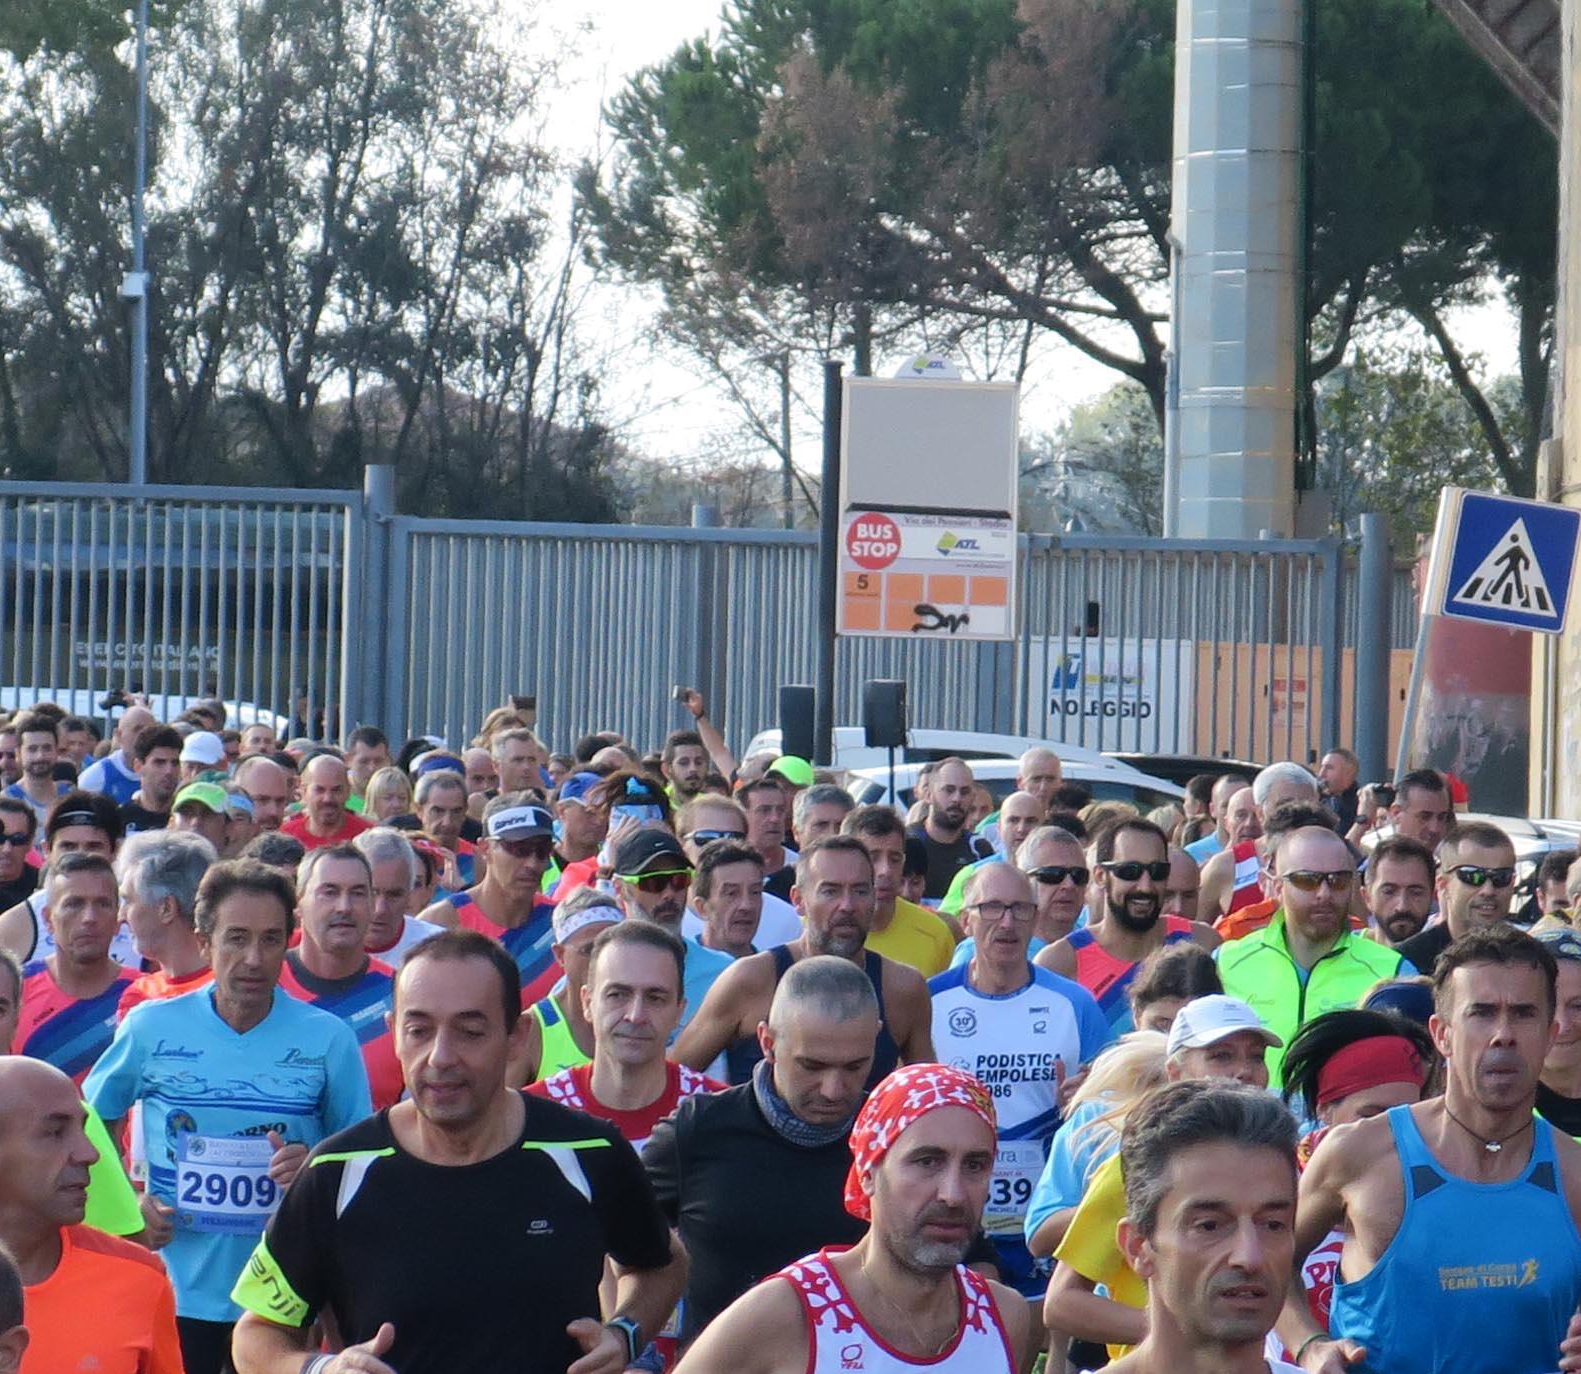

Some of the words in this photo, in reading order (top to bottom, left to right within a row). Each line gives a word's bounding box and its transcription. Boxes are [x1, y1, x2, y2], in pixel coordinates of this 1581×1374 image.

[857, 523, 892, 539] BUS
[851, 541, 897, 558] STOP
[857, 574, 869, 590] 5
[1050, 698, 1151, 718] NOLEGGIO
[181, 1170, 277, 1208] 2909
[986, 1178, 1032, 1206] 39
